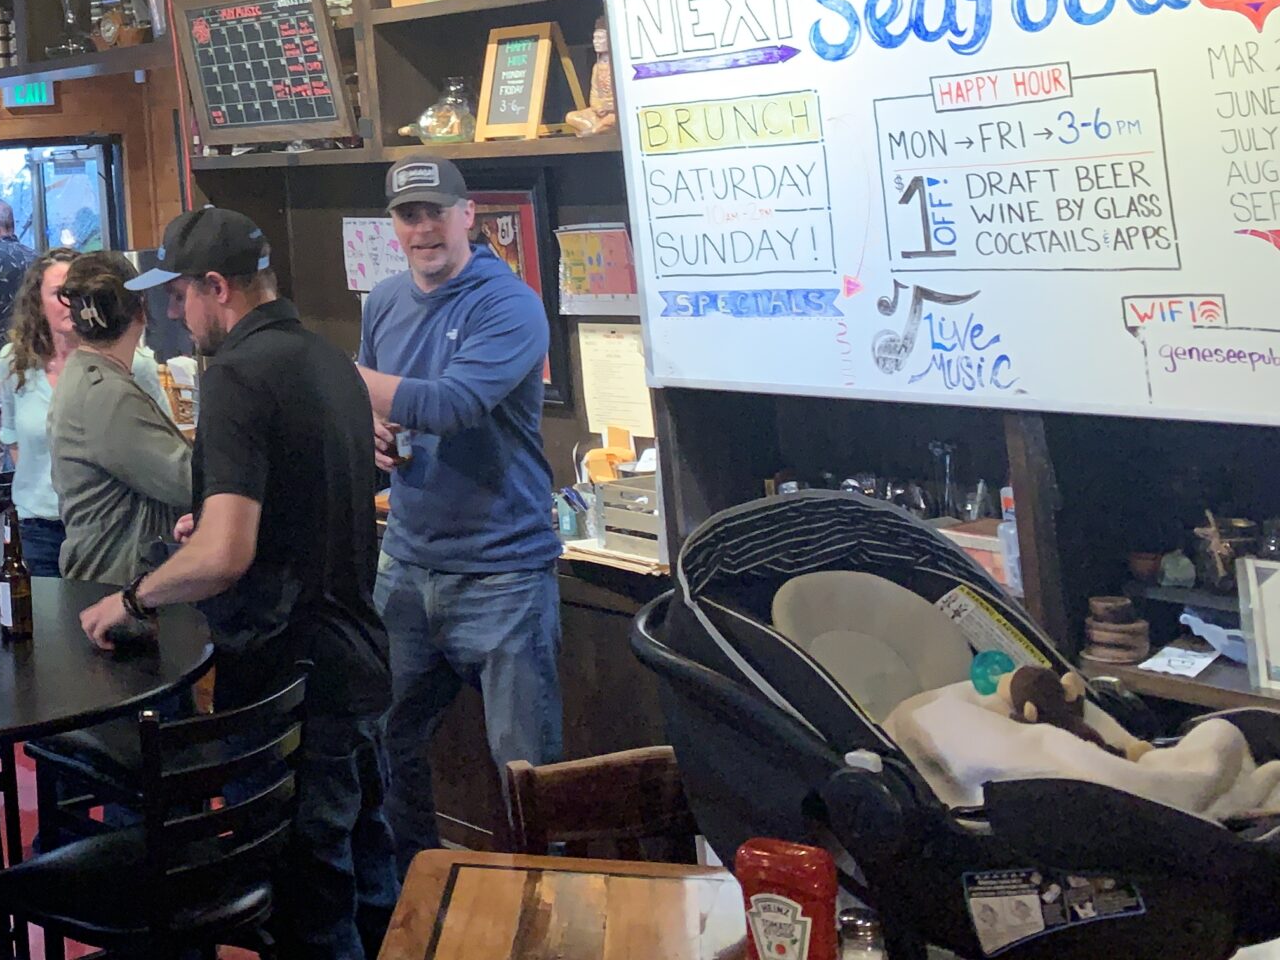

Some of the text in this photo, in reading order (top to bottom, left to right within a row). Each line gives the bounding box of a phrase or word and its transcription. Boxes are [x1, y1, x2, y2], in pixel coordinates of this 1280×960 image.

[1208, 41, 1264, 79] MAR
[939, 68, 1066, 106] HAPPY HOUR
[644, 100, 810, 147] BRUNCH
[889, 107, 1142, 160] MON FRI 3-6 PM
[1220, 127, 1278, 154] JULY
[650, 162, 816, 206] SATURDAY
[966, 160, 1151, 199] DRAFT BEER
[970, 194, 1162, 224] WINE BY GLASS
[975, 227, 1101, 255] COCKTAILS
[1113, 226, 1171, 252] APPS
[675, 291, 827, 315] SPECIALS
[1130, 301, 1197, 323] WIFI
[761, 903, 790, 917] HEINZ
